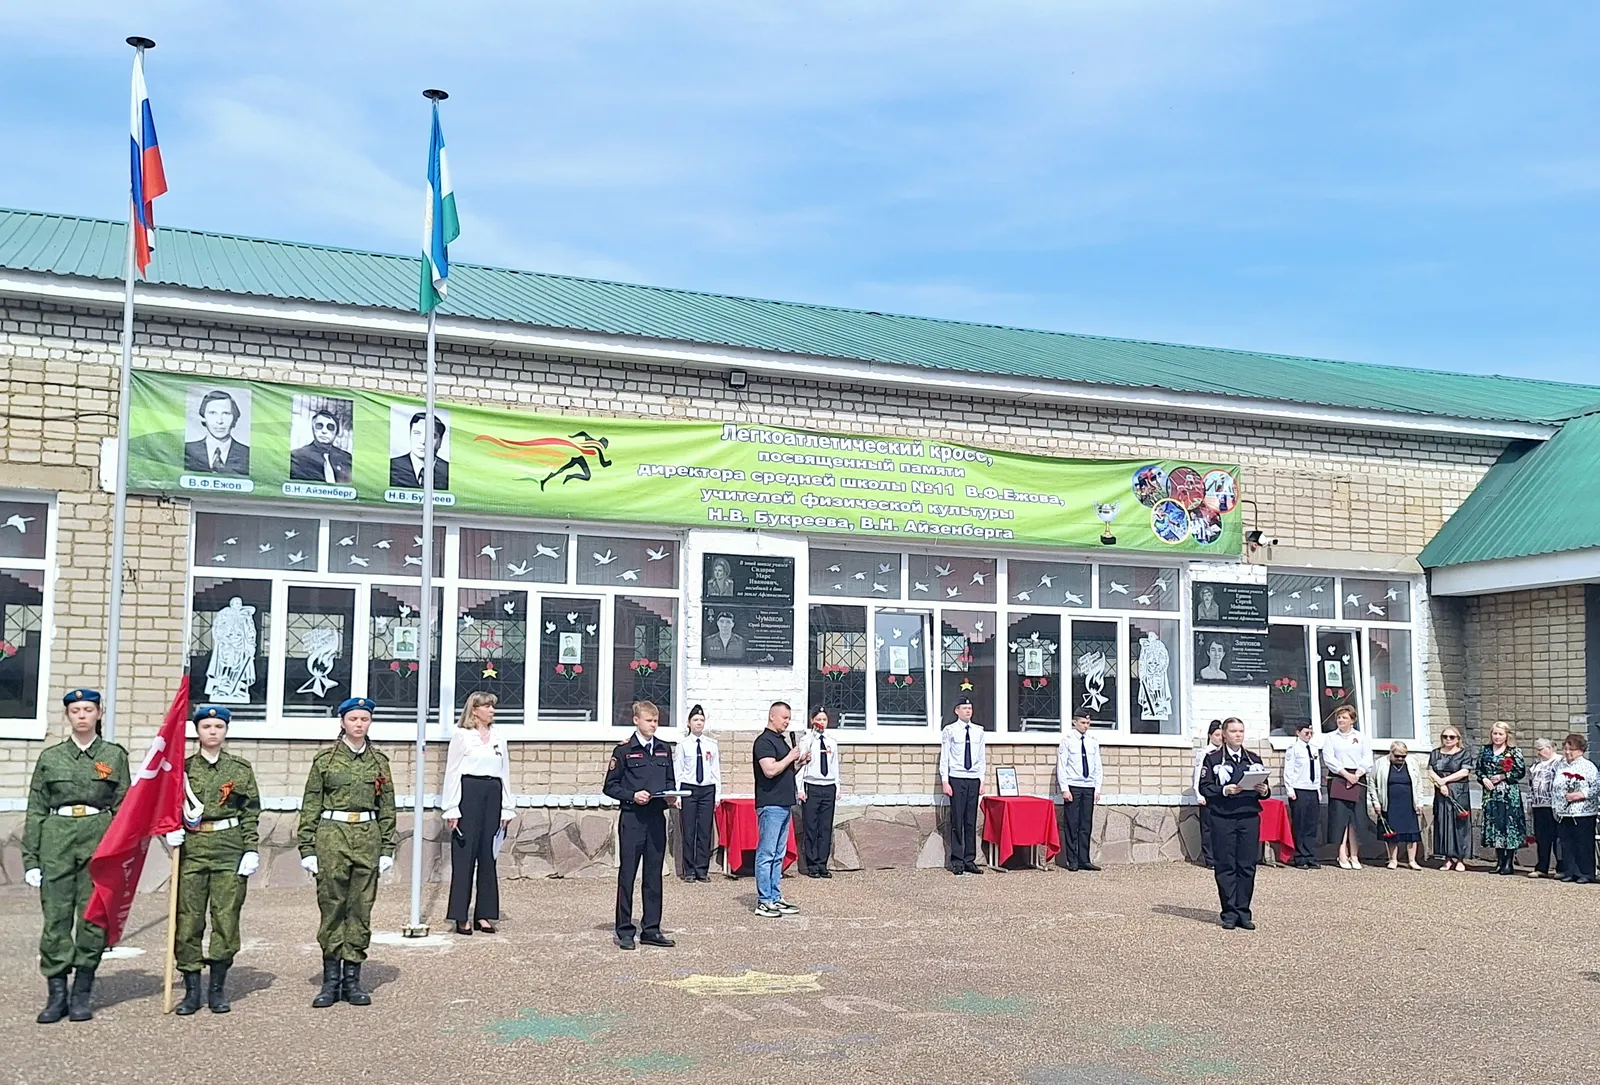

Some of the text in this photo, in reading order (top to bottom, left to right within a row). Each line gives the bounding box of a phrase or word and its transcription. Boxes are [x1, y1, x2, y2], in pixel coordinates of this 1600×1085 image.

[721, 423, 994, 466] Легкоатлетический кросс,
[758, 451, 965, 477] посвященный памяти
[188, 478, 242, 490] В.Ф.Ежов
[284, 484, 353, 498] В.Н. Айзенберг
[637, 463, 1065, 506] директора средней школы №11 В.Ф.Ежова,
[388, 492, 452, 503] Н.В. Буеев
[700, 488, 1014, 520] учителей физической культуры
[708, 508, 1014, 540] Н.В. Букреева, В.Н. Айзенберга
[755, 614, 784, 623] Чумаков
